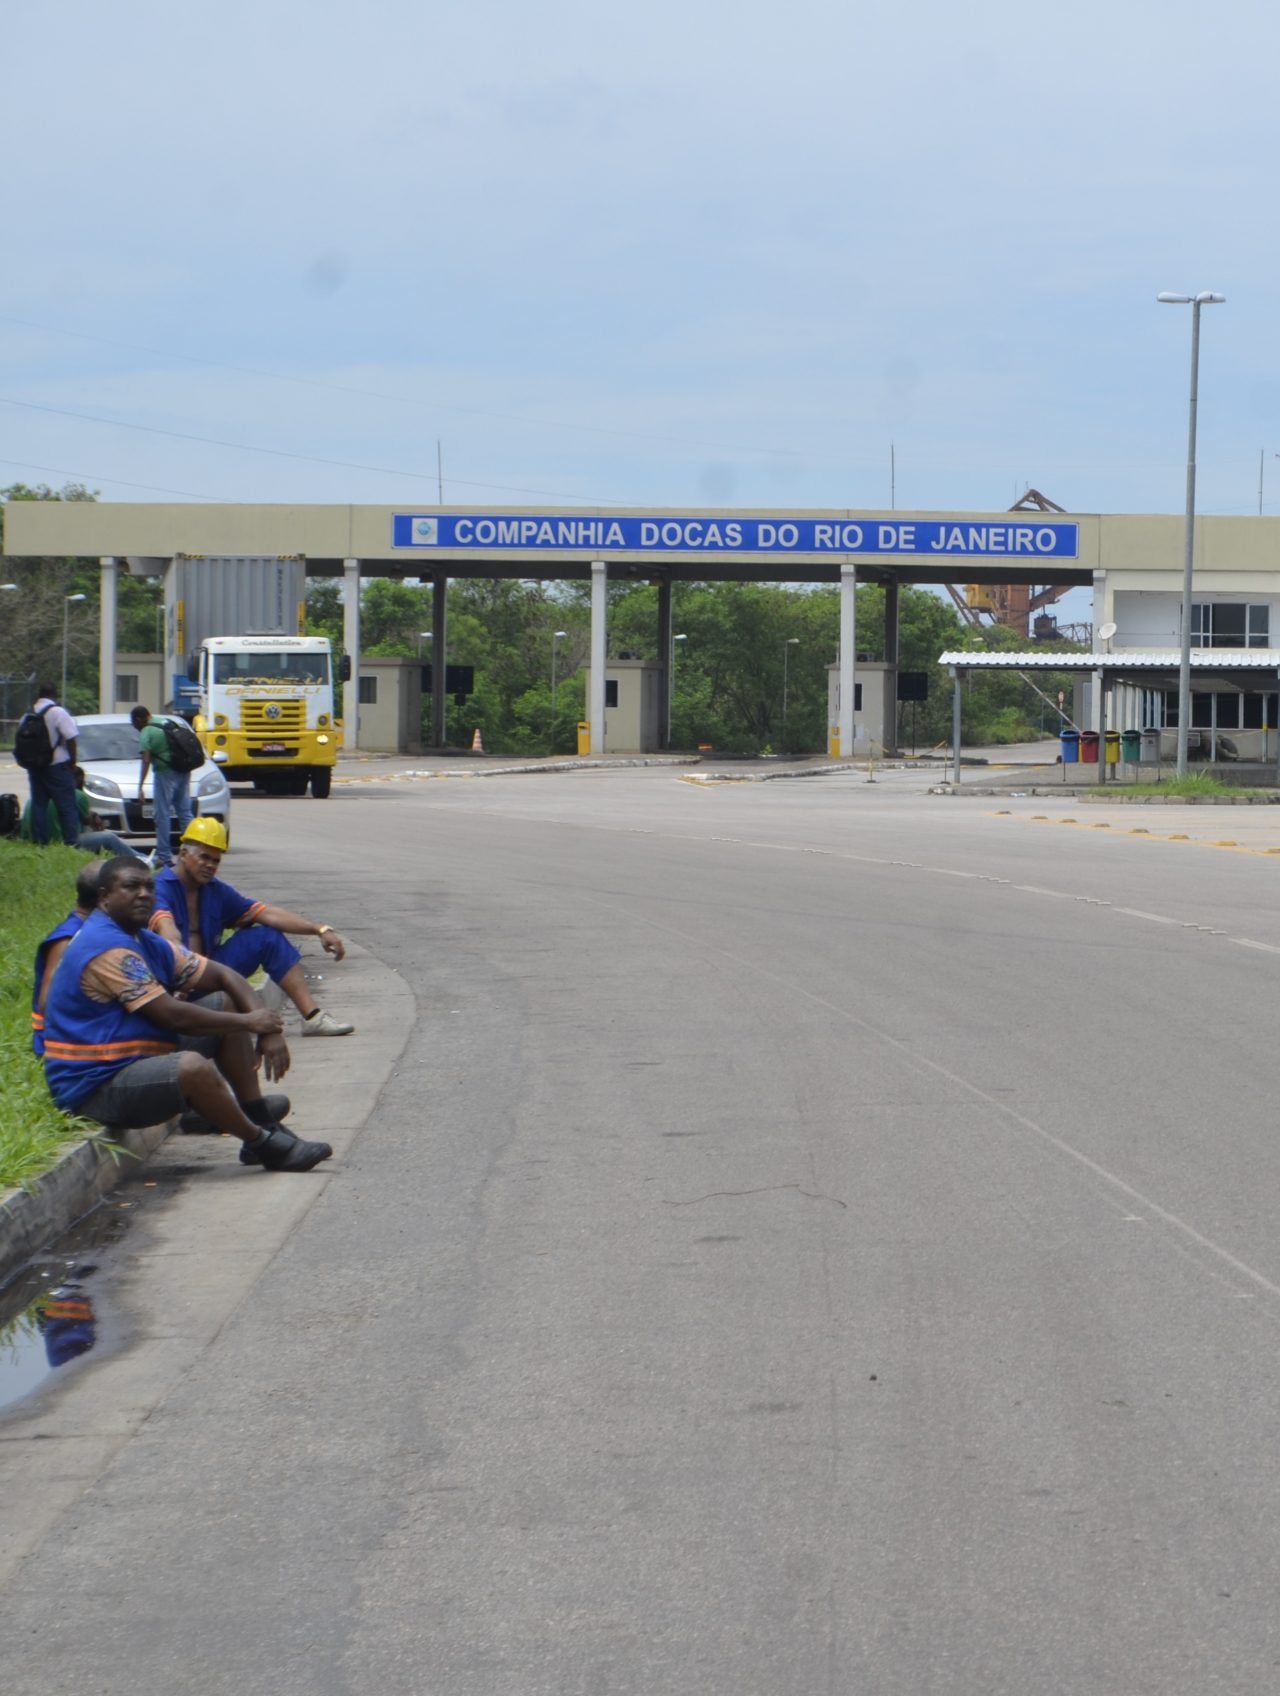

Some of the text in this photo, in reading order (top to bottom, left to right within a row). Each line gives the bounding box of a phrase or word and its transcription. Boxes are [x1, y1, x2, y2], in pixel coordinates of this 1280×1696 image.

[454, 519, 1057, 552] COMPANHIA DOCAS DO RIO DE JANEIRO
[224, 687, 322, 696] DANIELLI
